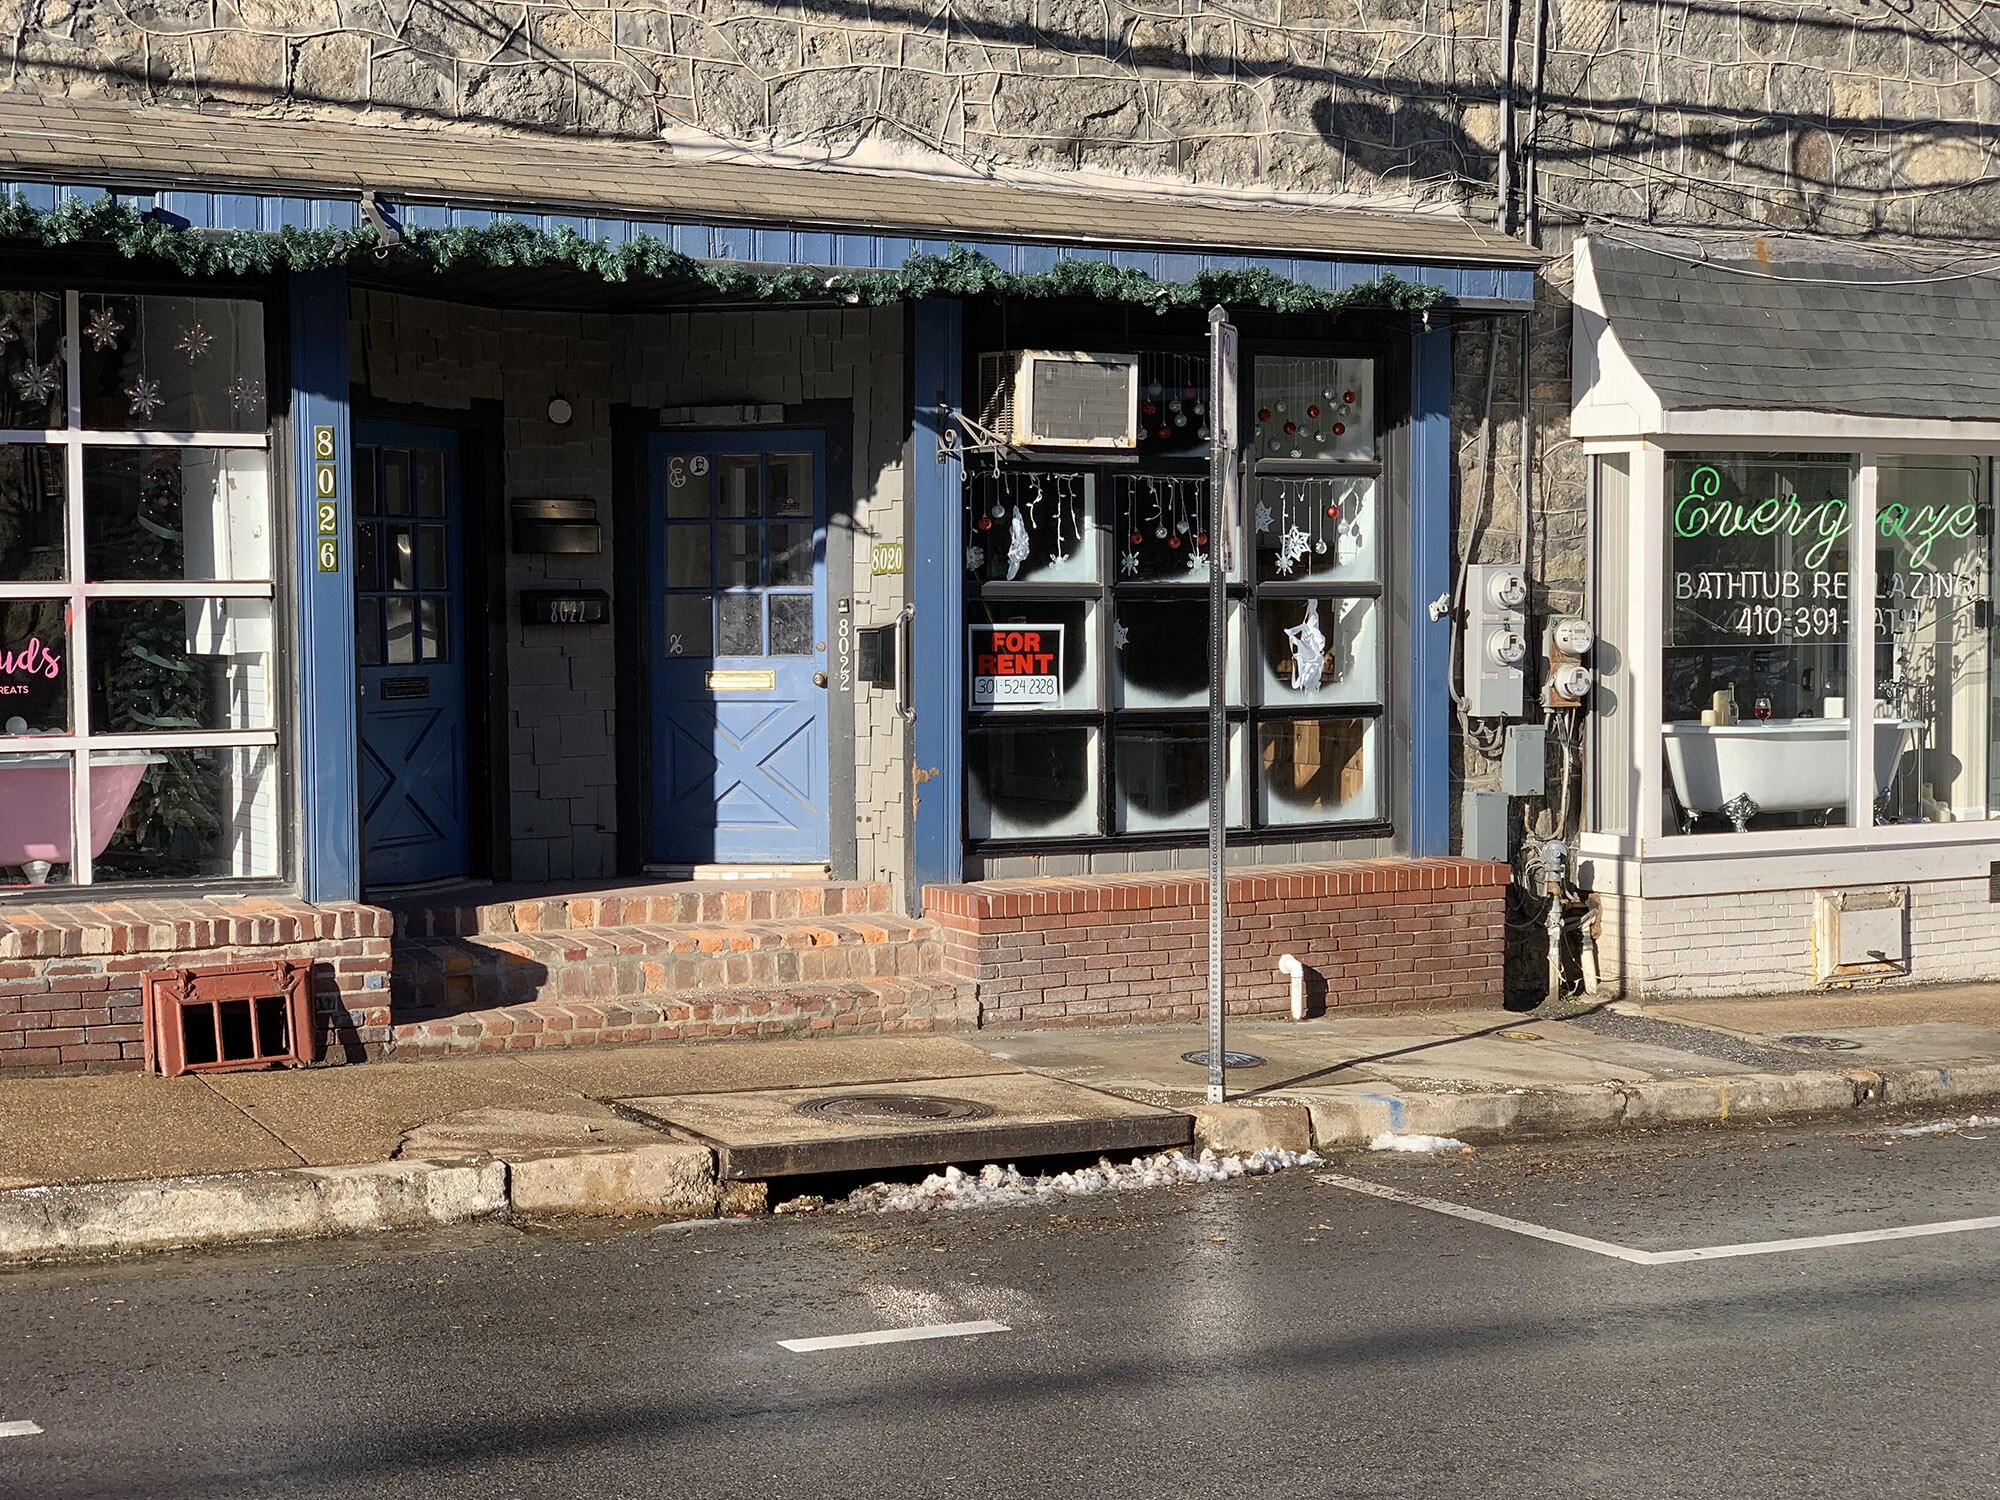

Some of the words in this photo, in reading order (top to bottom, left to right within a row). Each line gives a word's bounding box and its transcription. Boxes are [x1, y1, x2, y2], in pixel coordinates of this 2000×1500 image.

[317, 430, 336, 569] 8026
[1674, 466, 1978, 570] Evergaze
[871, 547, 904, 572] 8020
[1675, 571, 1801, 600] BATHTUB
[1812, 571, 1975, 600] RELAZING
[550, 601, 586, 623] 8022
[1735, 604, 1921, 638] 410-391-ATH
[838, 618, 850, 692] 8022
[992, 632, 1041, 652] FOR
[978, 653, 1054, 675] RENT
